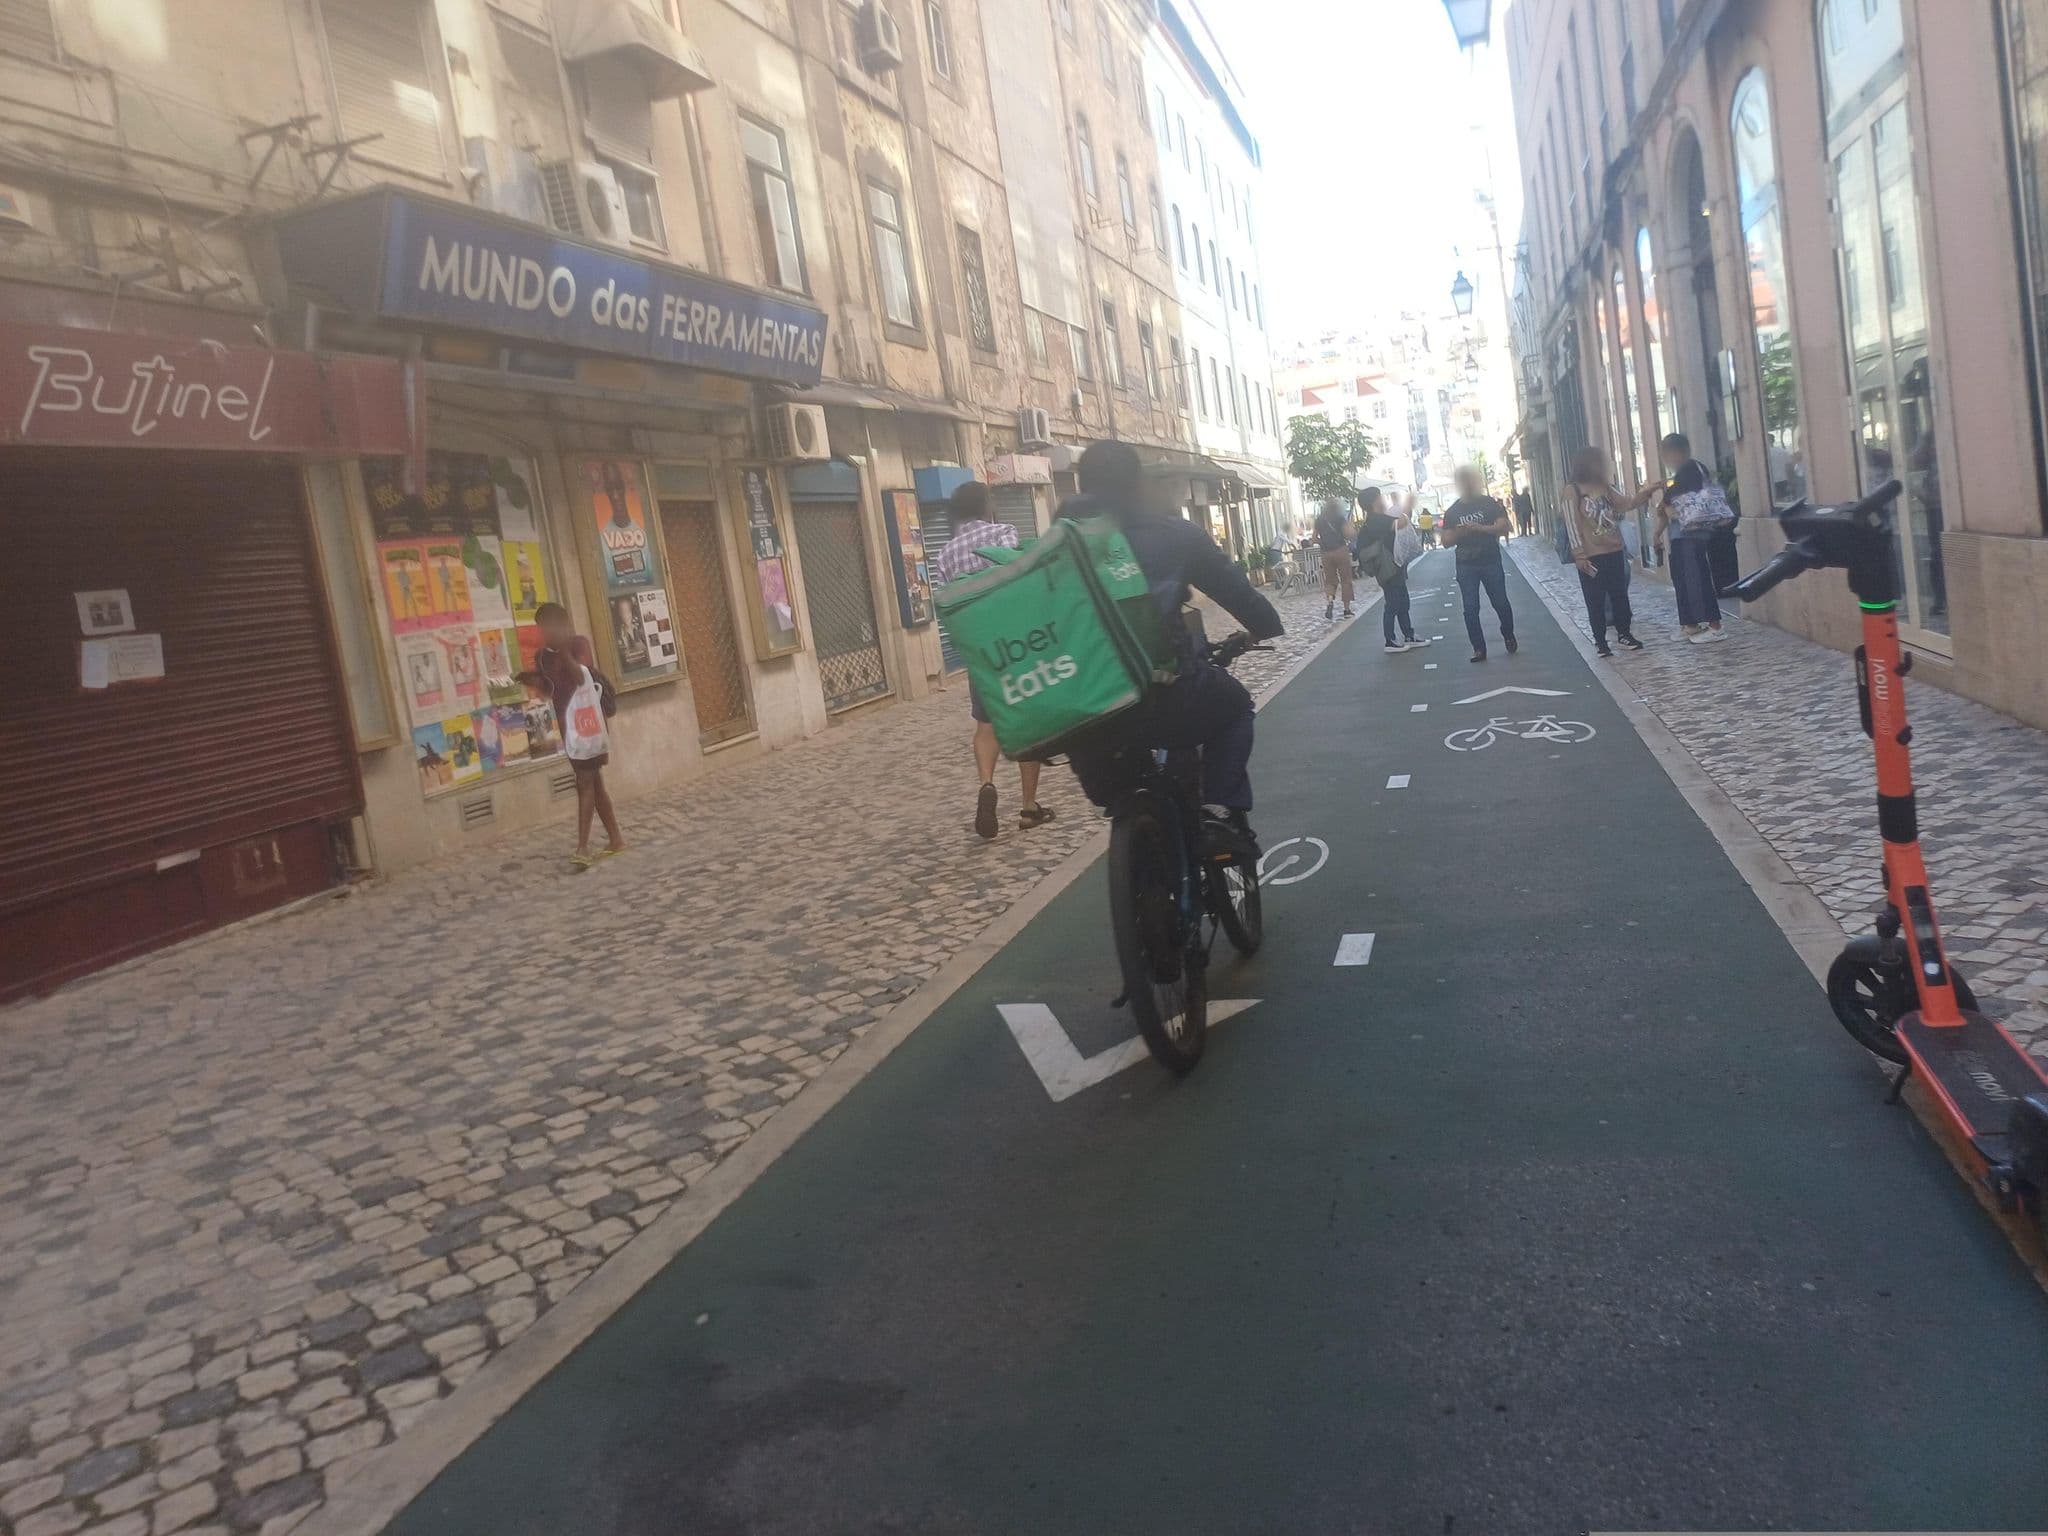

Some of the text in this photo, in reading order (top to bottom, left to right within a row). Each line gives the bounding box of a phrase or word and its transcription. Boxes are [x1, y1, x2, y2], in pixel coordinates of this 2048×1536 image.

[418, 236, 823, 366] MUNDO das FERRAMENTAS
[980, 620, 1060, 672] Uber
[1000, 654, 1078, 706] Eats
